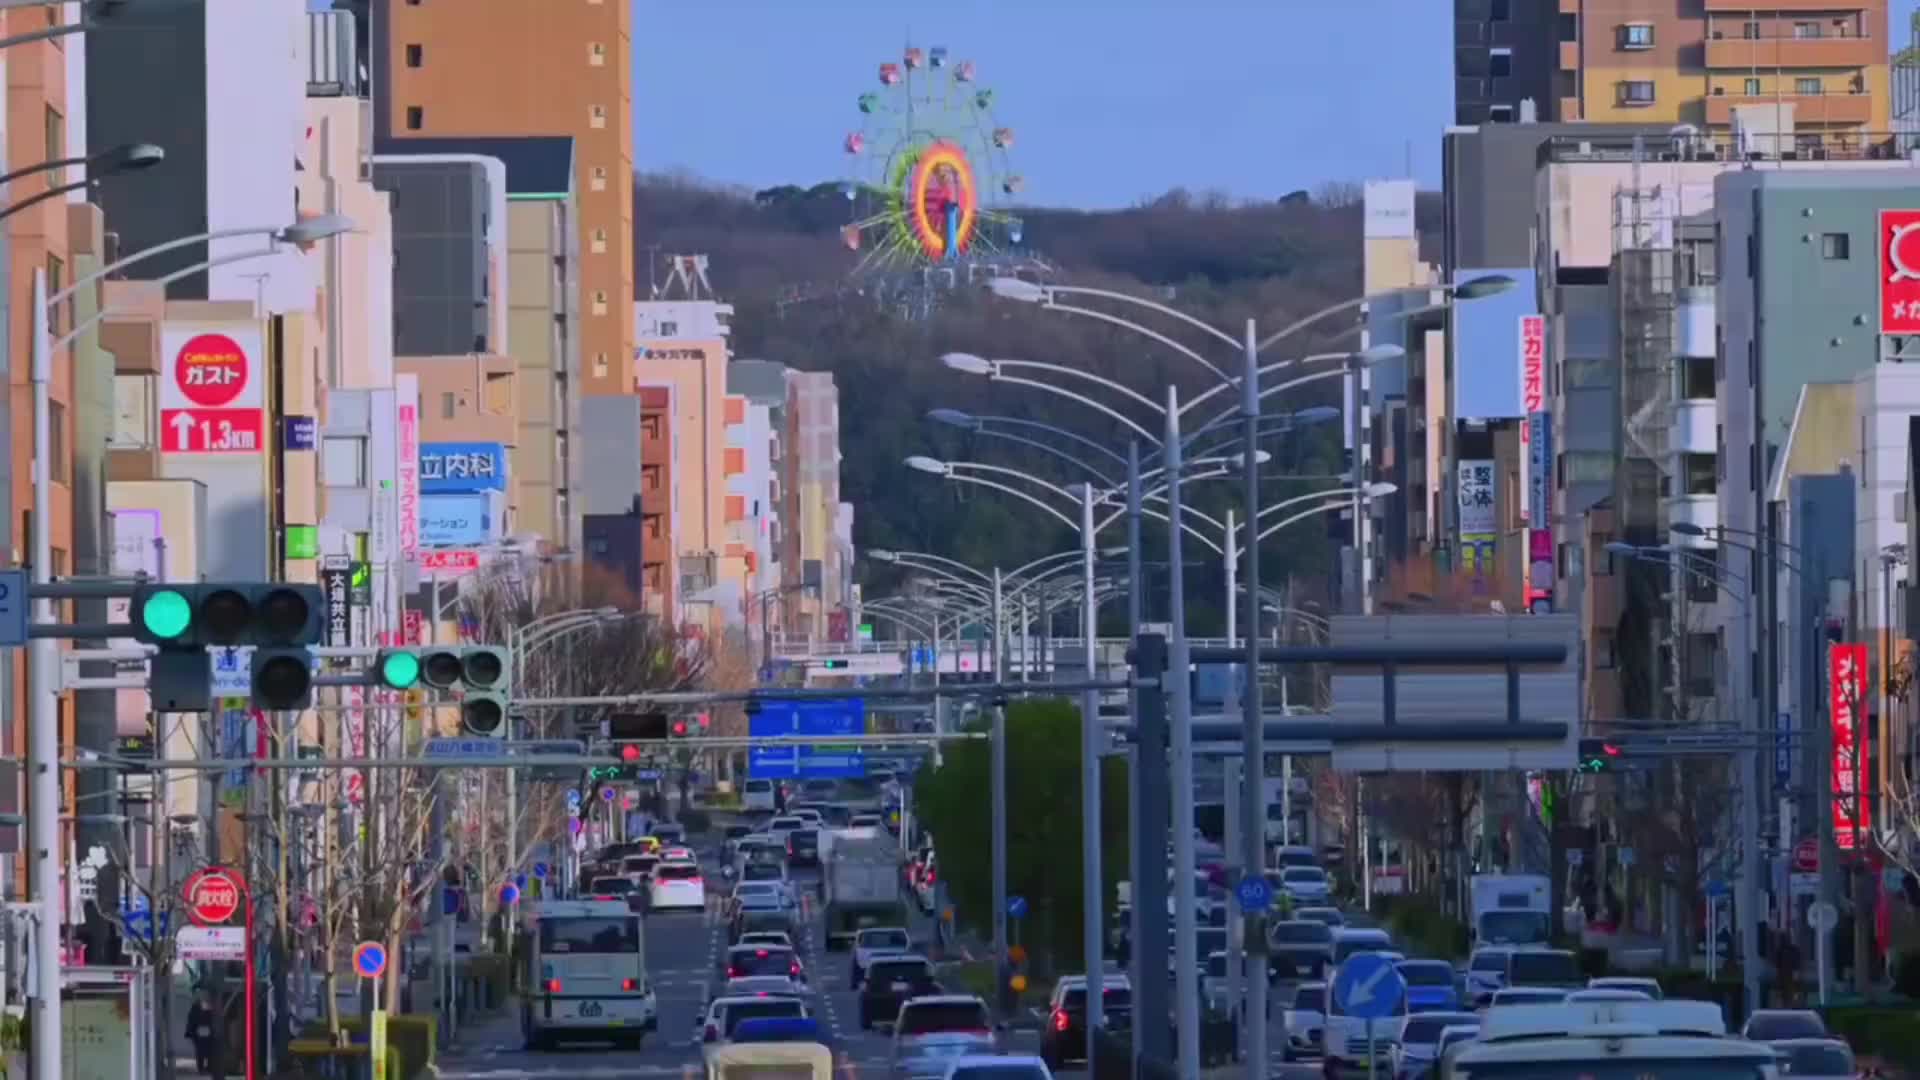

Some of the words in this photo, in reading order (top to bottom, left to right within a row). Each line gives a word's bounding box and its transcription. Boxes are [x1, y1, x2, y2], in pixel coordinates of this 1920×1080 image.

[185, 365, 240, 385] ガスト
[1524, 337, 1543, 412] カラオケ
[200, 420, 256, 449] 1.3km
[420, 453, 494, 479] 立内科
[1474, 465, 1493, 508] 整体
